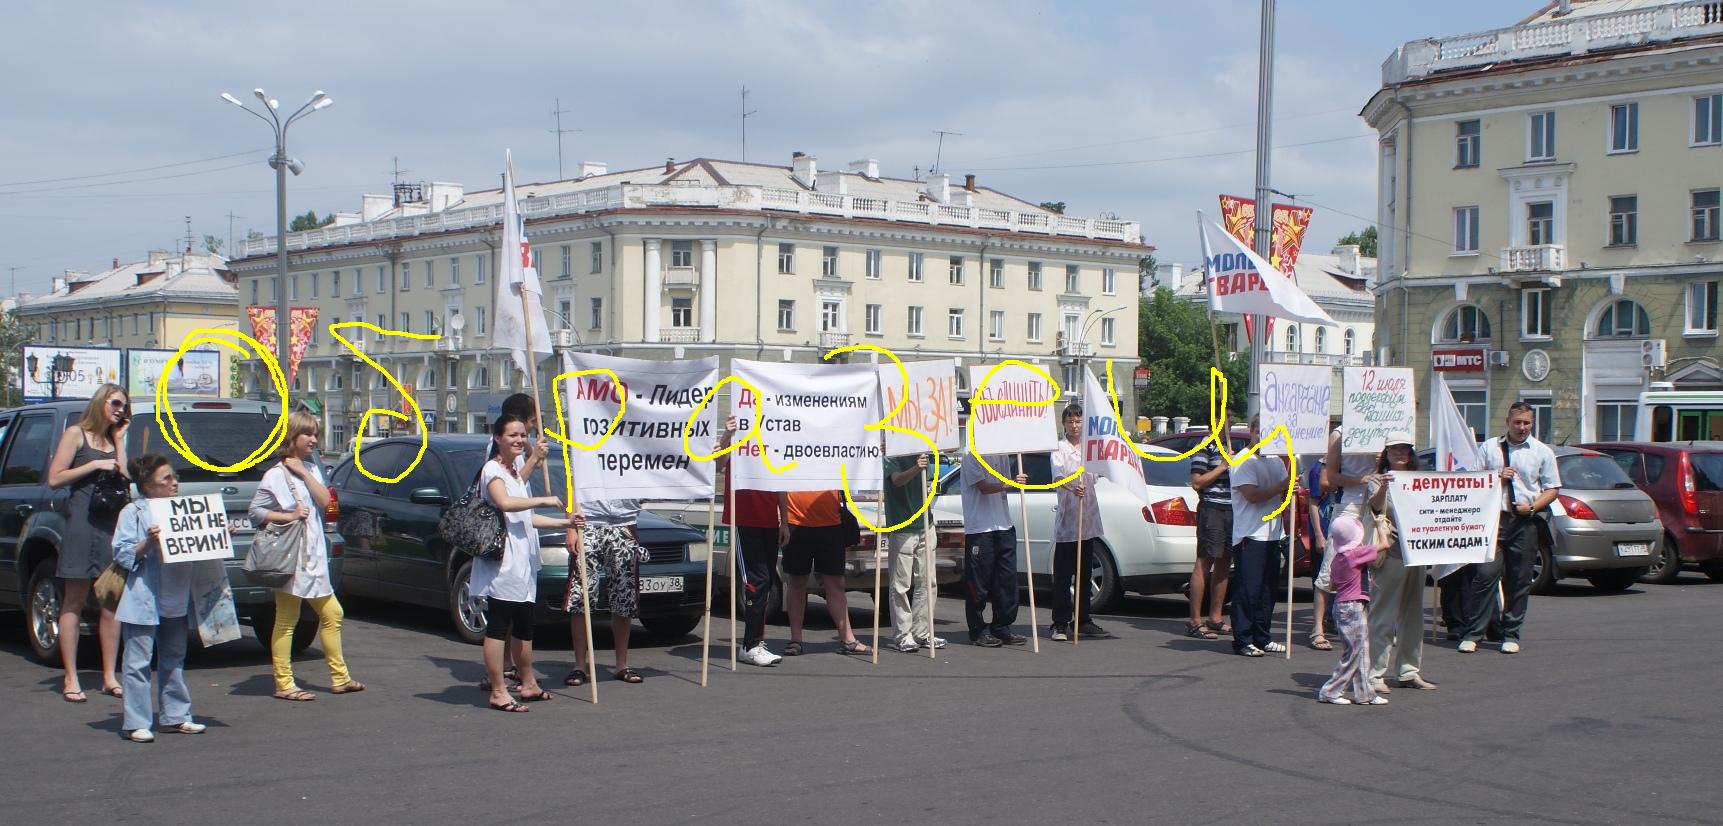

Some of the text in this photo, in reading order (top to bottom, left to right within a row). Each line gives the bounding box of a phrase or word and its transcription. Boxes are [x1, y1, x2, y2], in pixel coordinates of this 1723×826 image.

[1456, 355, 1482, 366] МТС
[1363, 369, 1376, 391] 12
[649, 384, 715, 408] Лидер
[775, 394, 867, 409] изменениям
[887, 375, 953, 443] МЫ ЗА!
[739, 418, 749, 431] в
[783, 444, 879, 460] двоевластию
[1412, 476, 1484, 494] депутаты
[170, 496, 210, 516] МЫ
[1431, 494, 1468, 503] ЗАРПЛАТУ
[1440, 506, 1481, 516] менеджера
[169, 513, 226, 532] ВАМ НЕ
[1434, 515, 1462, 524] отдайте
[1422, 525, 1459, 535] туалетную
[1461, 522, 1486, 533] бумагу
[165, 529, 229, 556] ВЕРИМ!
[1447, 536, 1482, 549] САДАМ
